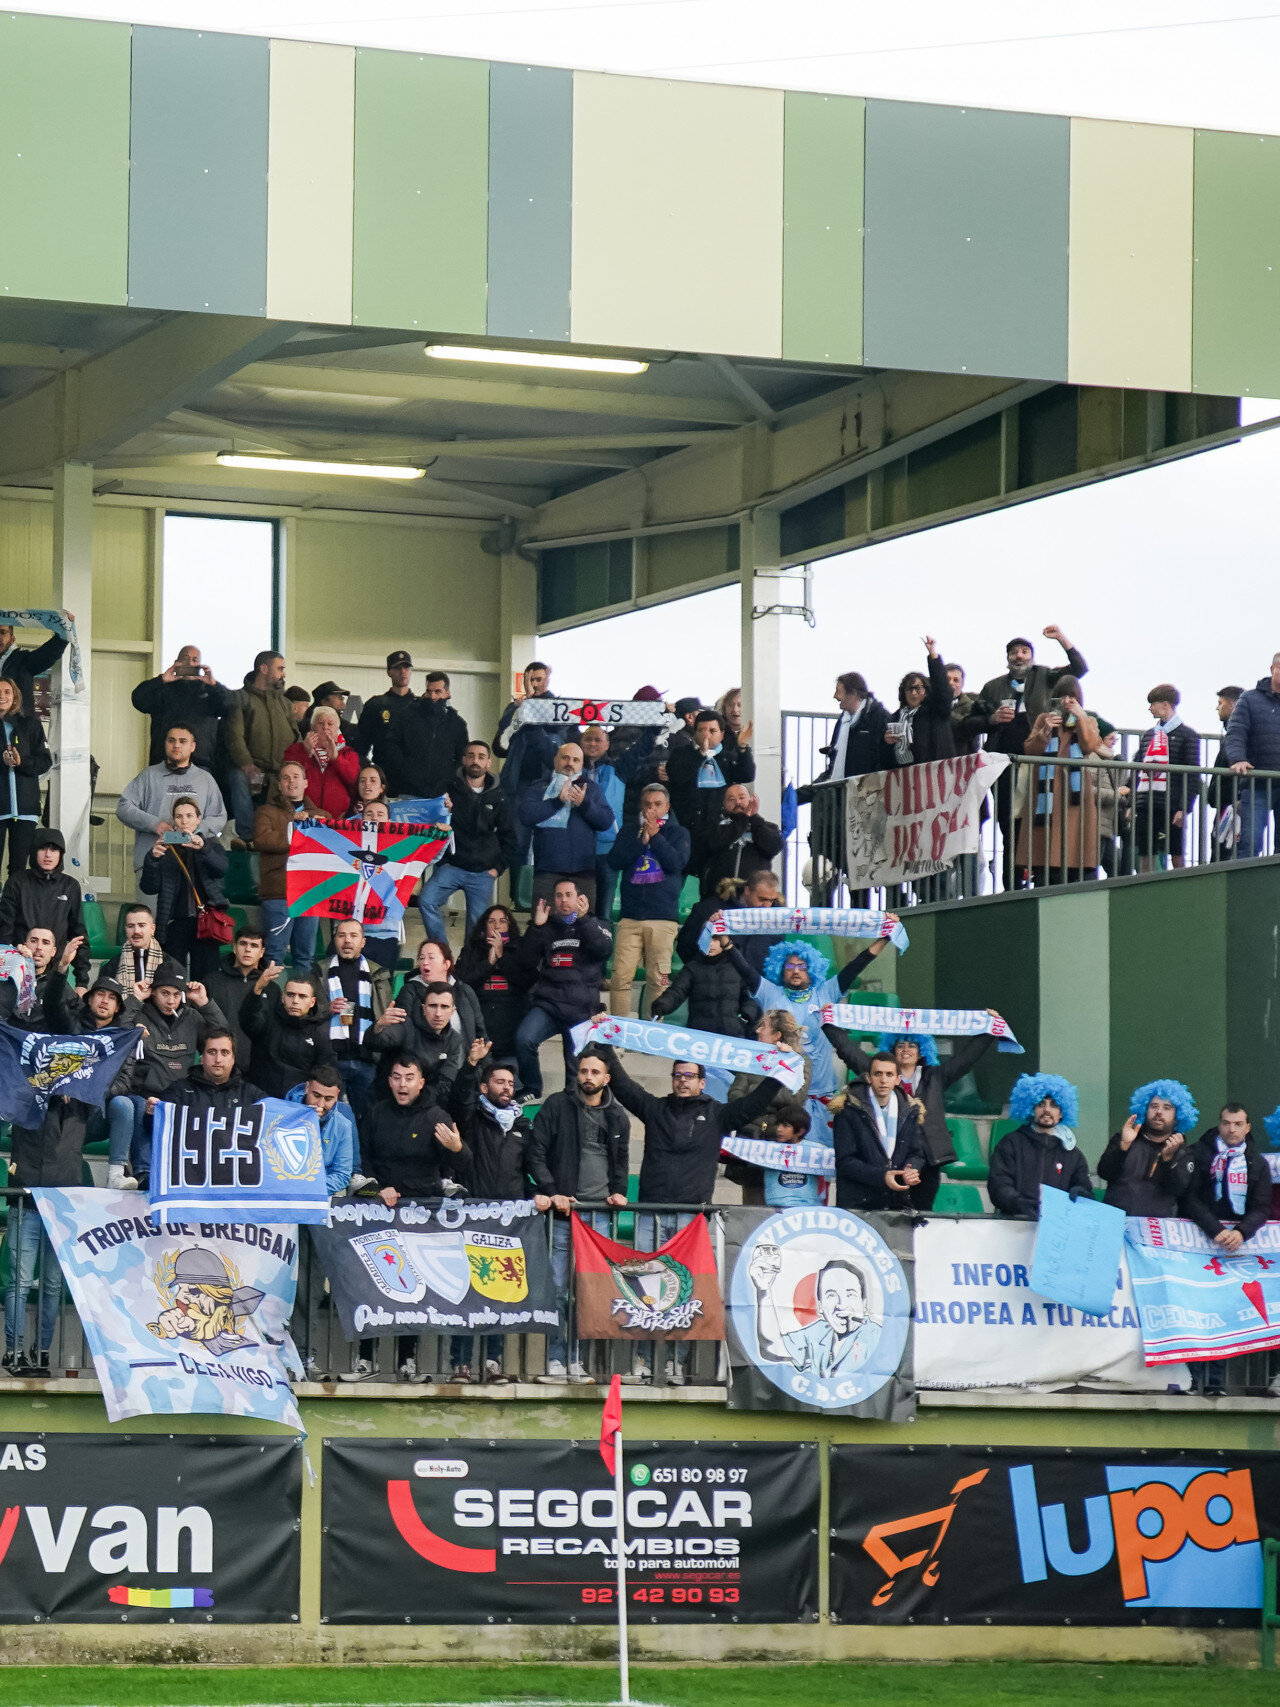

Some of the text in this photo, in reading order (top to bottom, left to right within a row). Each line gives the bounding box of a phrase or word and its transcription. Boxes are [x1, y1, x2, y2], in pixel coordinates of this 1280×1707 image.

[389, 823, 405, 835] DE
[170, 1101, 267, 1189] 1923
[77, 1214, 161, 1256] TROPAS
[200, 1222, 297, 1267] BREOGAN
[471, 1233, 513, 1249] GALIZA
[757, 1211, 902, 1294] VIVIDORES
[612, 1298, 703, 1319] FONDO SUR
[914, 1301, 1074, 1327] UROPEA A TU
[622, 1313, 695, 1332] BURGOS
[652, 1467, 748, 1483] 651 80 98 97
[454, 1489, 753, 1528] SEGOCAR
[1009, 1464, 1260, 1602] lupa
[502, 1538, 740, 1555] RECAMBIOS
[638, 1556, 740, 1573] para automóvil
[655, 1572, 741, 1583] www.segocar.es
[633, 1588, 664, 1604] 42
[671, 1588, 703, 1604] 90
[708, 1588, 740, 1604] 93
